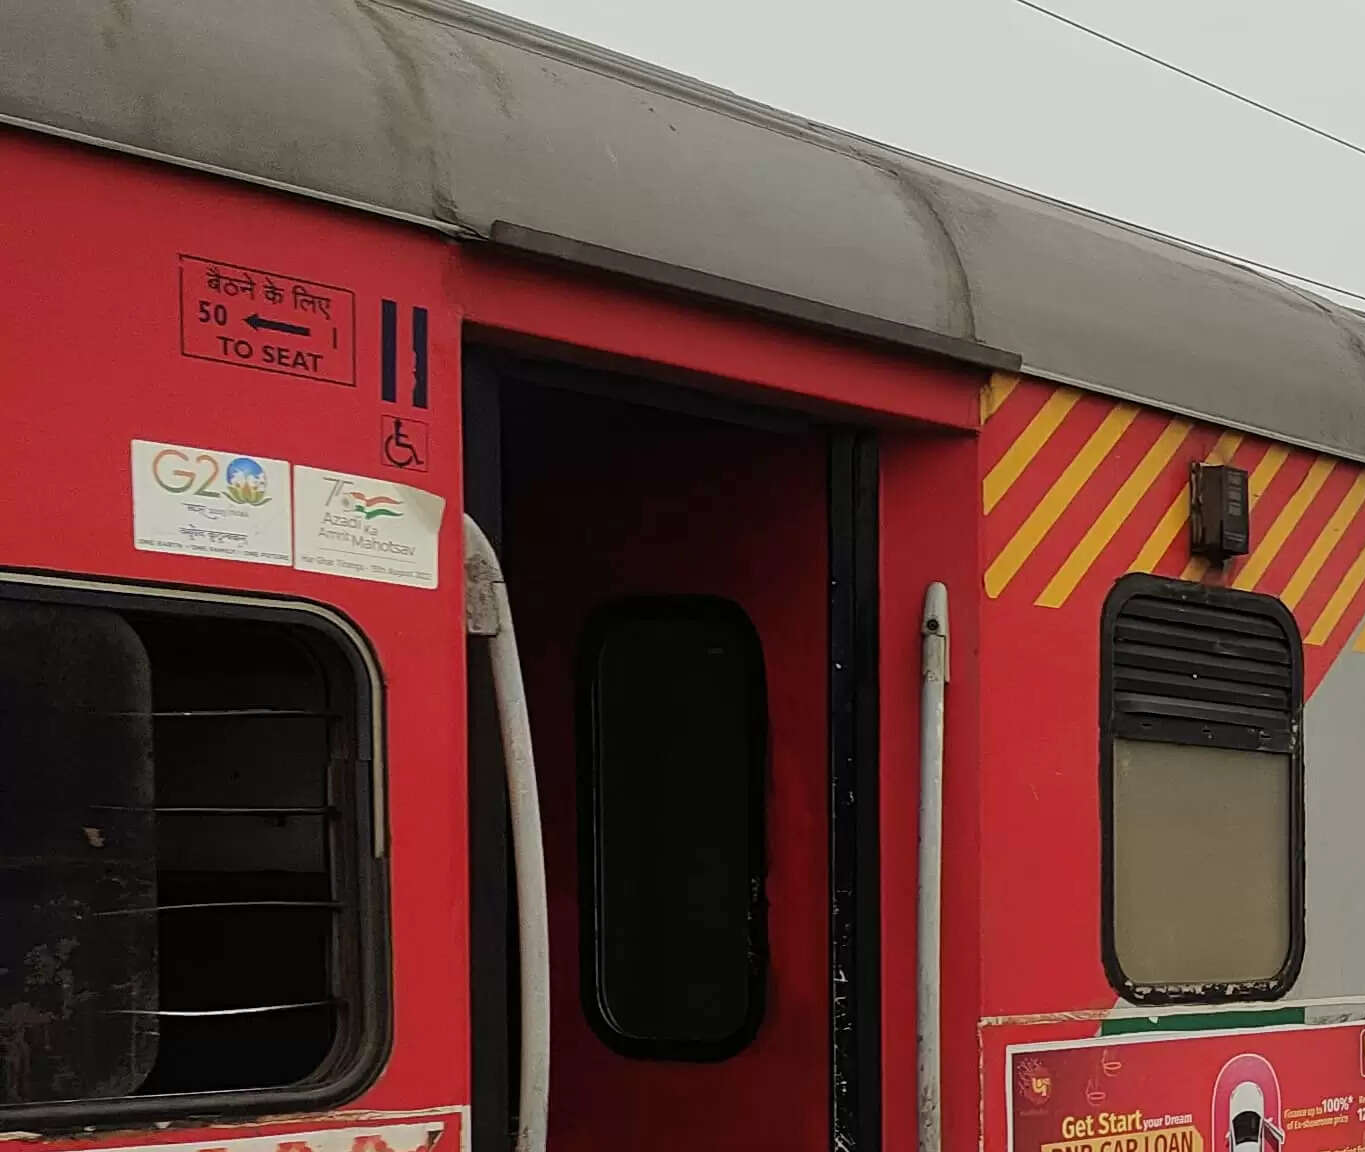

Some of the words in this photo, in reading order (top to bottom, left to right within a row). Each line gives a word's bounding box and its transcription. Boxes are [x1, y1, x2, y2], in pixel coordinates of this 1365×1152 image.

[206, 264, 256, 300] बैठने
[263, 277, 284, 304] के
[291, 284, 332, 321] लिए
[198, 300, 227, 326] 50
[217, 335, 253, 359] TO
[262, 345, 324, 373] SEAT
[152, 449, 272, 507] G20
[321, 512, 361, 529] Azadi
[352, 535, 416, 556] Mahotsav
[1062, 1114, 1094, 1138] Get
[1099, 1109, 1143, 1135] Start
[1143, 1116, 1163, 1131] your
[1165, 1112, 1193, 1125] Dream
